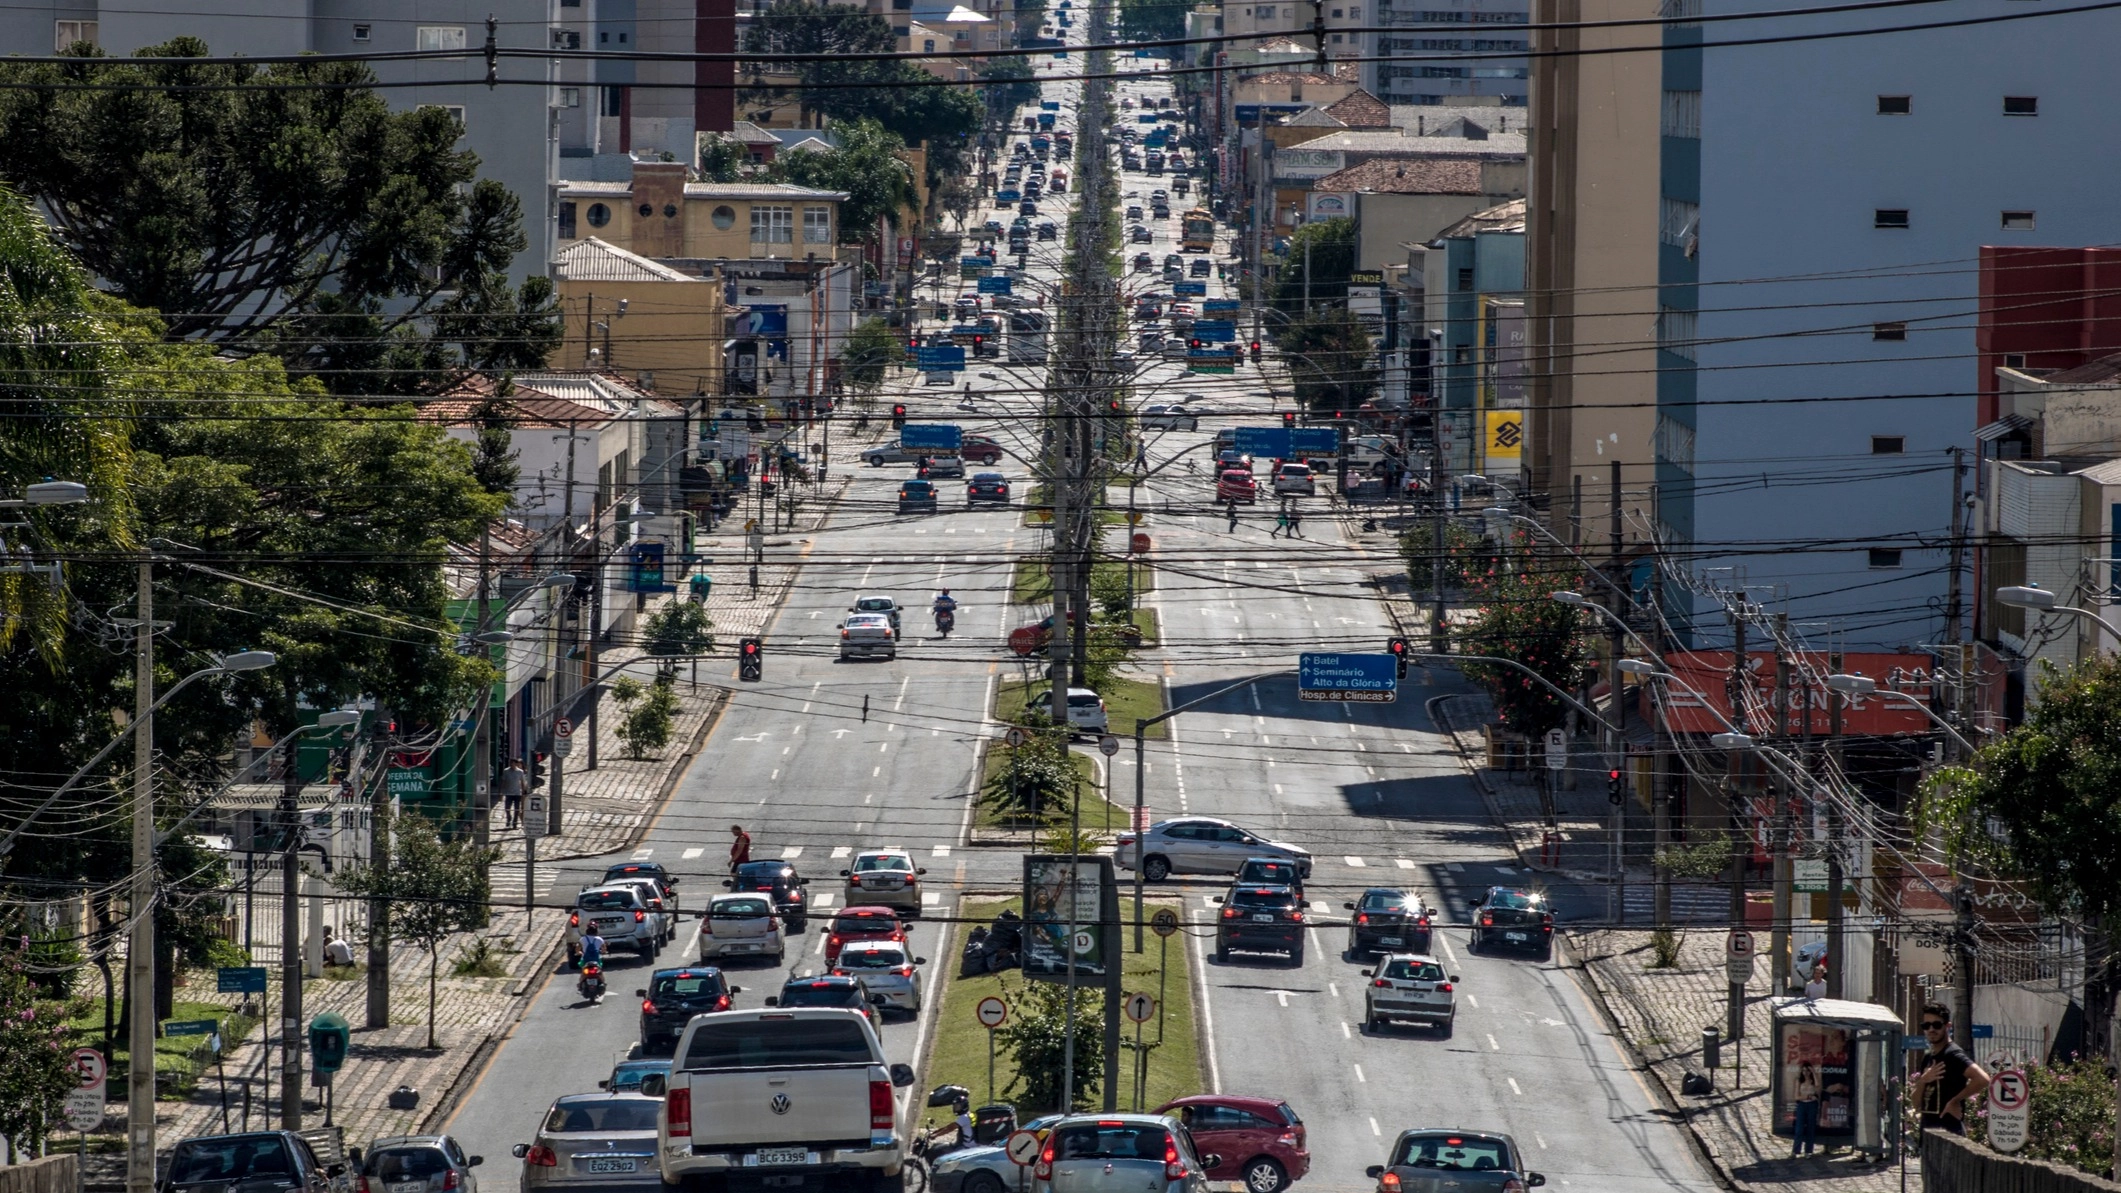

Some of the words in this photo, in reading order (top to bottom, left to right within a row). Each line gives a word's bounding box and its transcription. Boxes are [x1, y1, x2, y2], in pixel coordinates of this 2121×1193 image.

[1351, 274, 1381, 283] VENDE
[1009, 637, 1034, 645] PARE
[1313, 656, 1339, 665] Batel
[1313, 667, 1364, 676] Seminário
[1313, 678, 1333, 687] Alto
[1335, 678, 1348, 687] da
[1350, 678, 1382, 687] Glória
[1344, 691, 1384, 700] Clínicas
[1158, 914, 1173, 926] 50
[1916, 940, 1939, 949] DOS
[1814, 1066, 1848, 1074] TACIONAR
